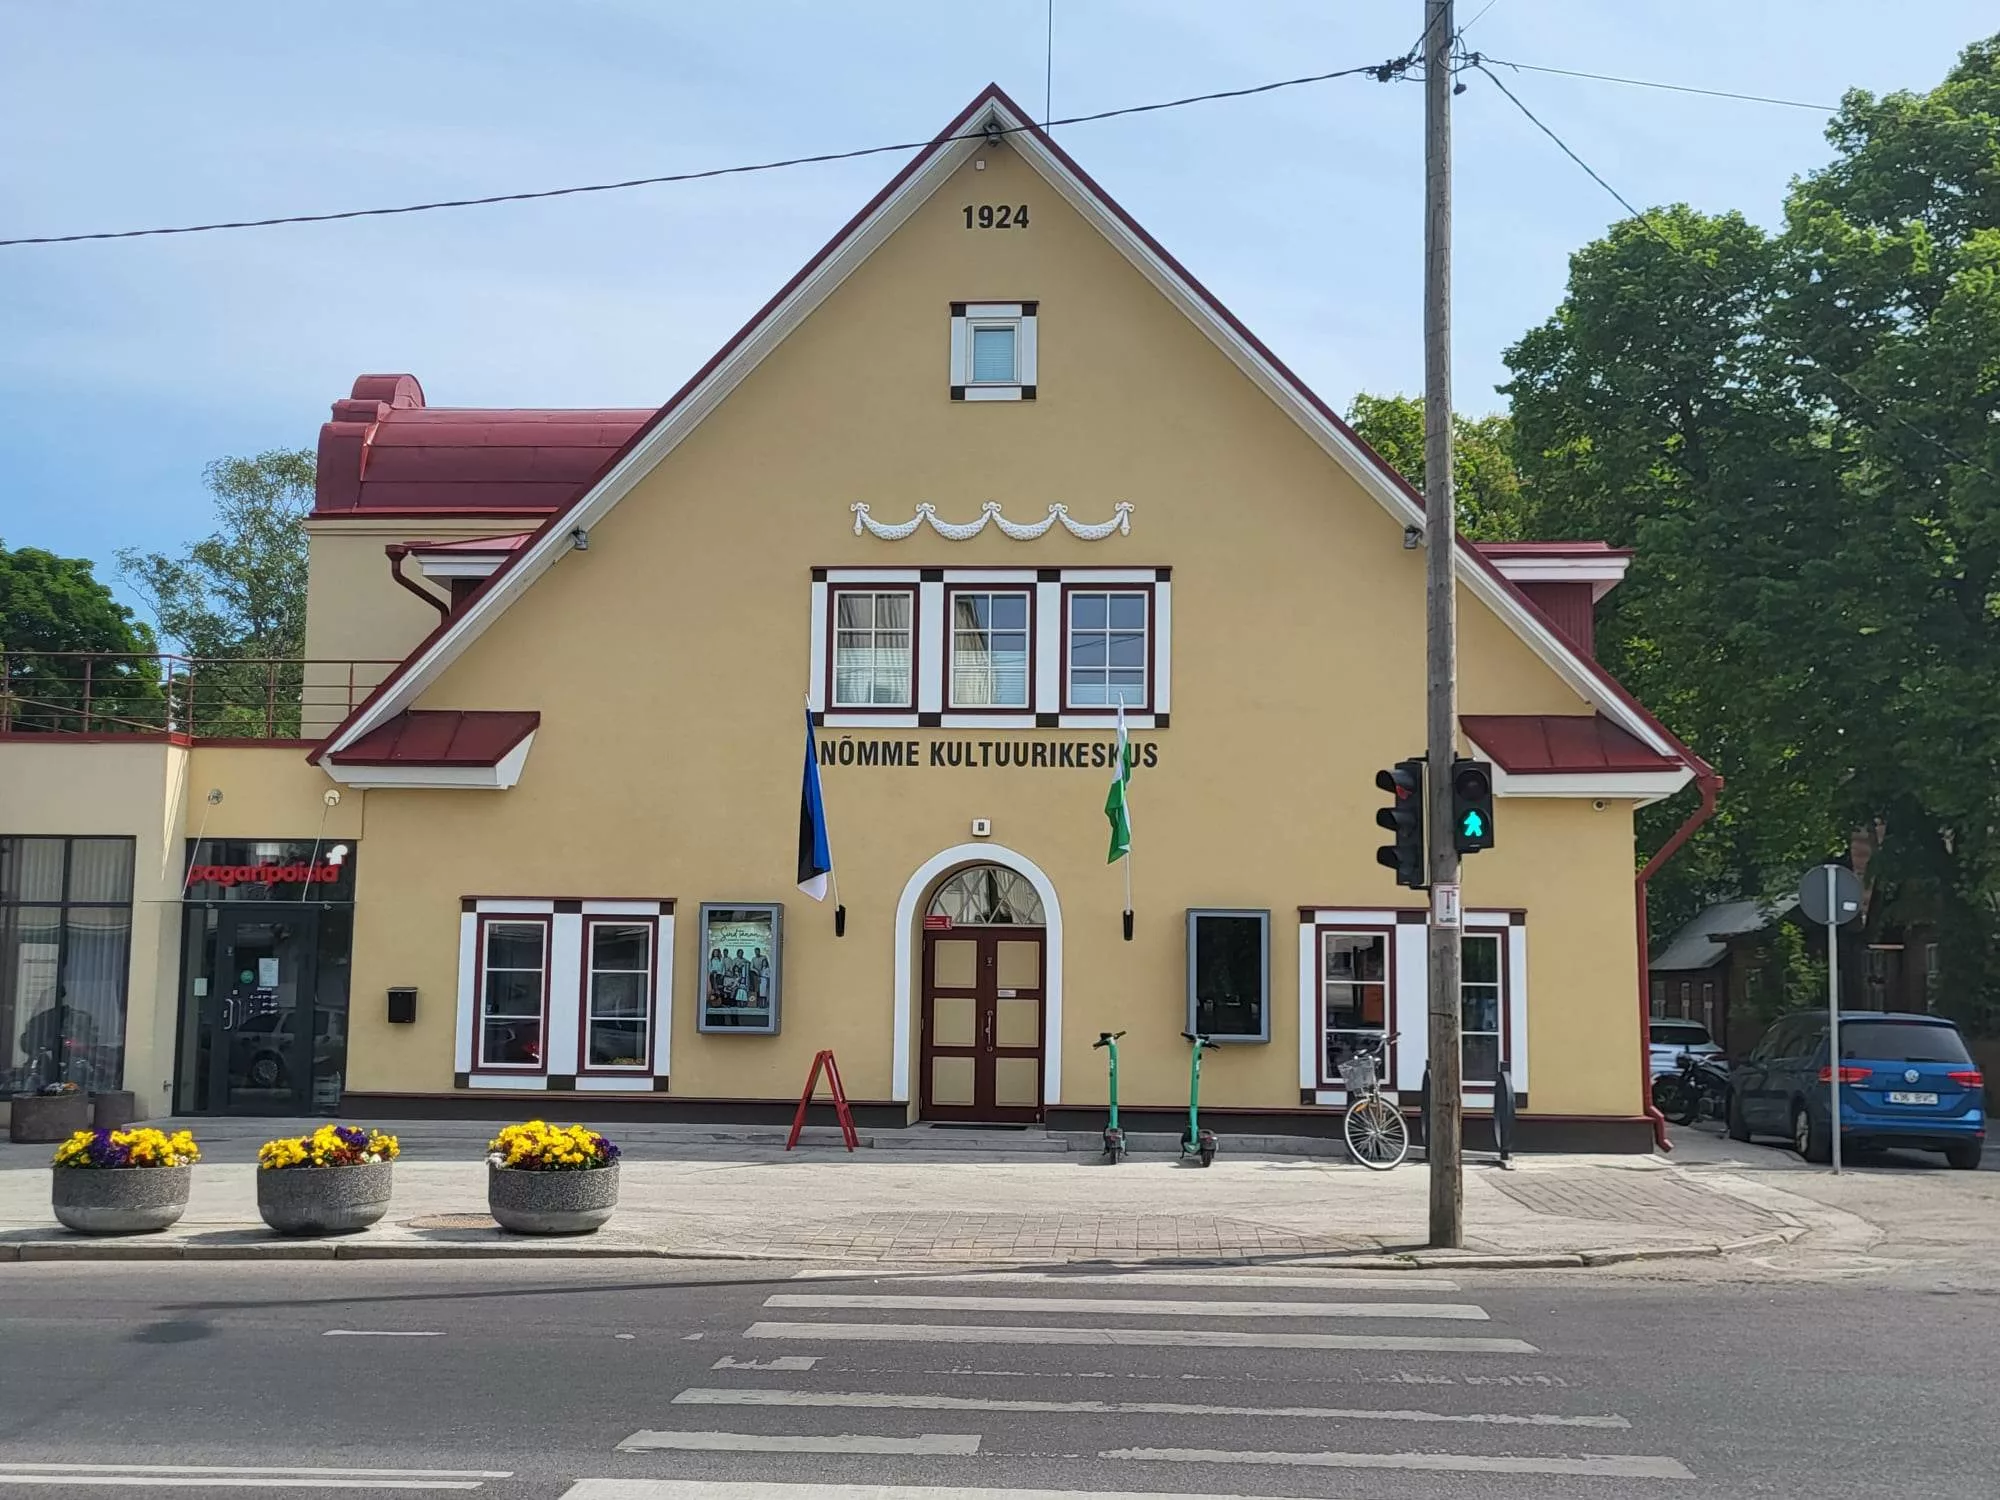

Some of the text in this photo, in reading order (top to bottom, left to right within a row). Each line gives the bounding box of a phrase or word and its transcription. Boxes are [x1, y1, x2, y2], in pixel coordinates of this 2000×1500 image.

[962, 204, 1030, 230] 1924
[822, 735, 1159, 769] NÕMME KULTUURIKESKUS
